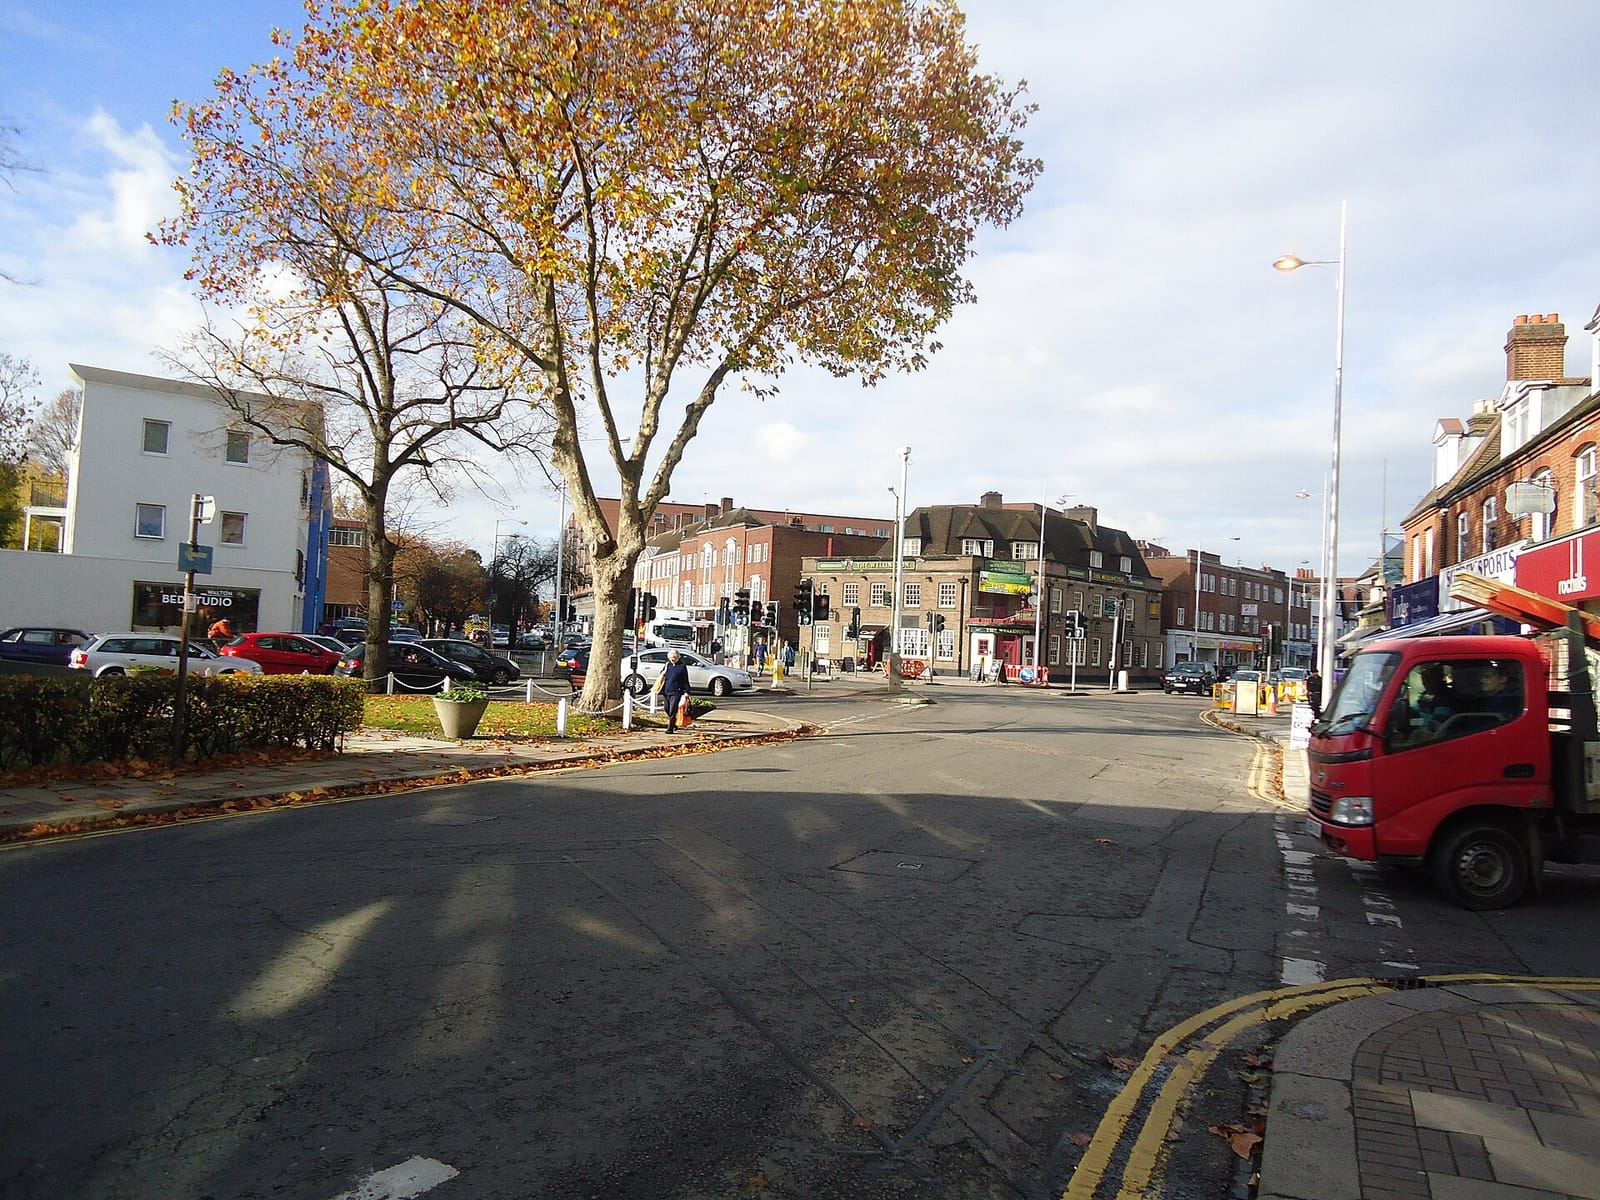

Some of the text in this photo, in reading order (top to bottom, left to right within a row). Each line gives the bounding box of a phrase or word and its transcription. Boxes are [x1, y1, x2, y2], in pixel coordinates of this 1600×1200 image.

[1446, 549, 1517, 588] SUY SPORTS
[162, 594, 184, 604] BED
[195, 596, 233, 607] TUDIO
